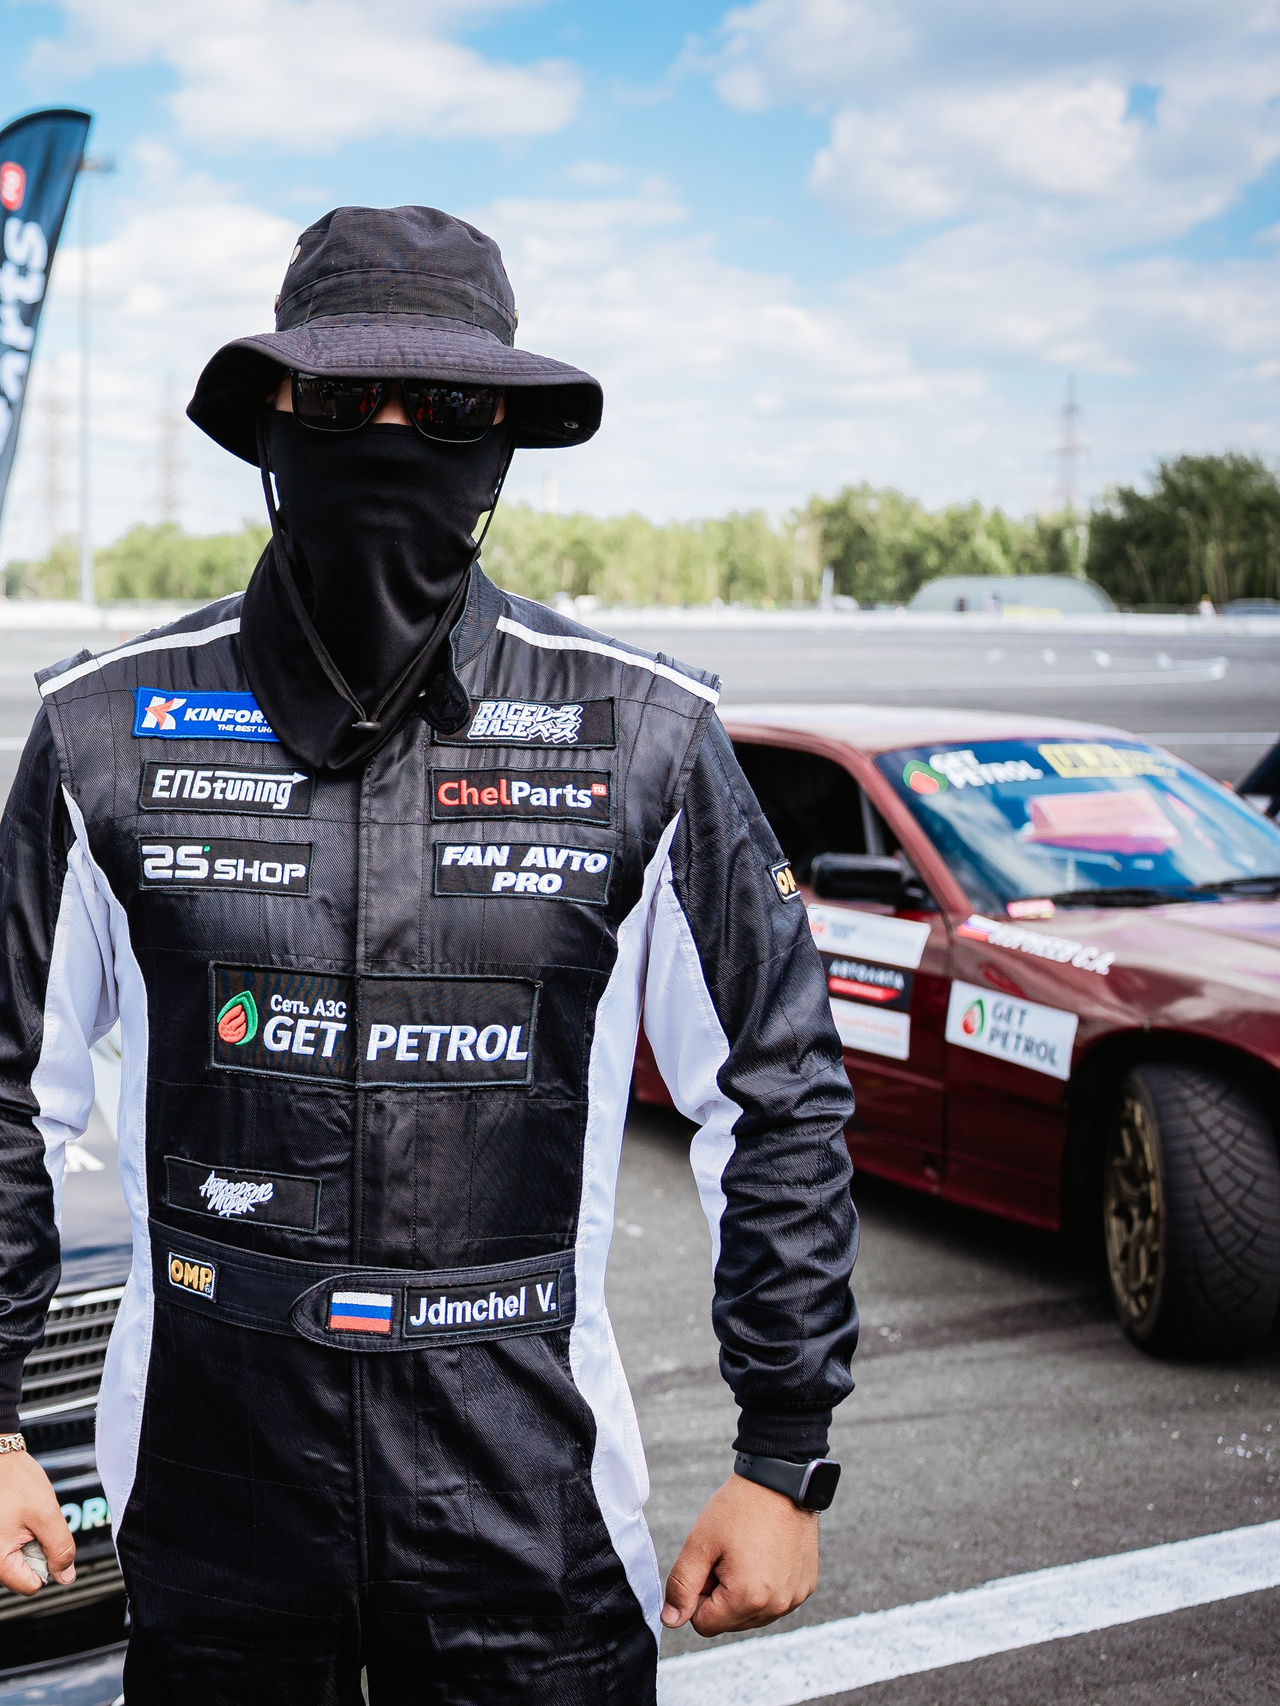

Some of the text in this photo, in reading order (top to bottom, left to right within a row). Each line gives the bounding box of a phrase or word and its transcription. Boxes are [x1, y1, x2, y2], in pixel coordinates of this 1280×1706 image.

[183, 707, 268, 724] KINFOR
[476, 702, 539, 721] RACE
[217, 724, 234, 732] THE
[235, 725, 257, 733] BEST
[467, 719, 532, 740] BASE
[437, 779, 593, 809] ChelParts
[213, 858, 307, 885] SHOP
[441, 845, 608, 874] FAN AVTO
[491, 871, 563, 894] PRO
[270, 994, 347, 1019] Сеть АЗС
[991, 1000, 1030, 1027] GET
[263, 1015, 529, 1062] GET PETROL
[987, 1028, 1060, 1068] PETROL
[171, 1259, 213, 1292] OMP
[410, 1281, 557, 1326] Jdmchel V.
